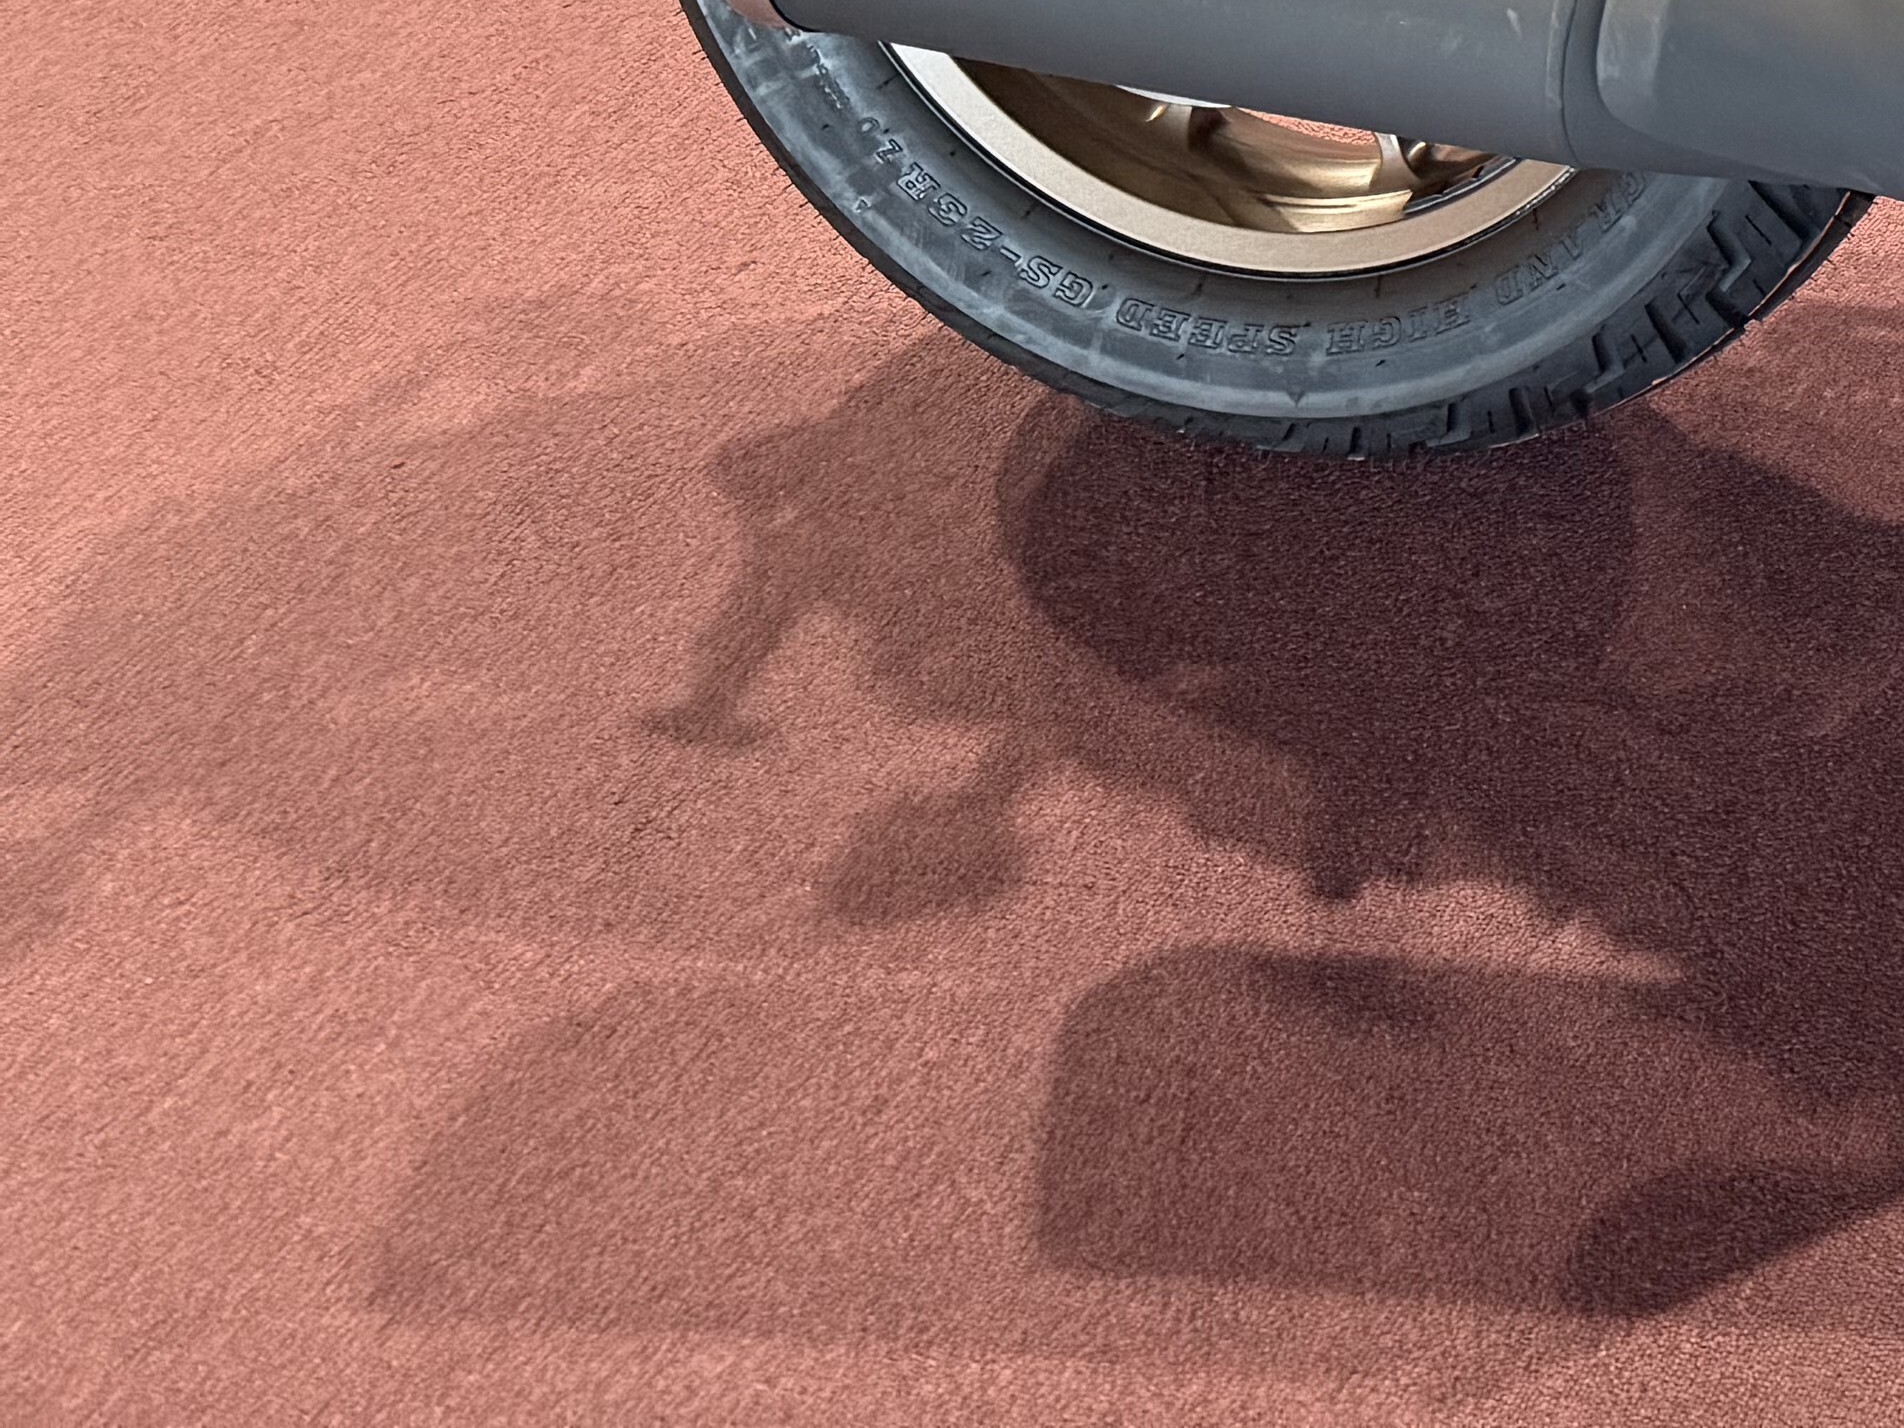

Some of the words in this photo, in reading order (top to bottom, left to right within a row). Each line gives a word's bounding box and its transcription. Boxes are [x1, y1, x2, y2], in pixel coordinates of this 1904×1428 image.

[896, 161, 1095, 308] GS-23R
[1115, 297, 1299, 358] SPEED
[1325, 299, 1471, 358] HIGH
